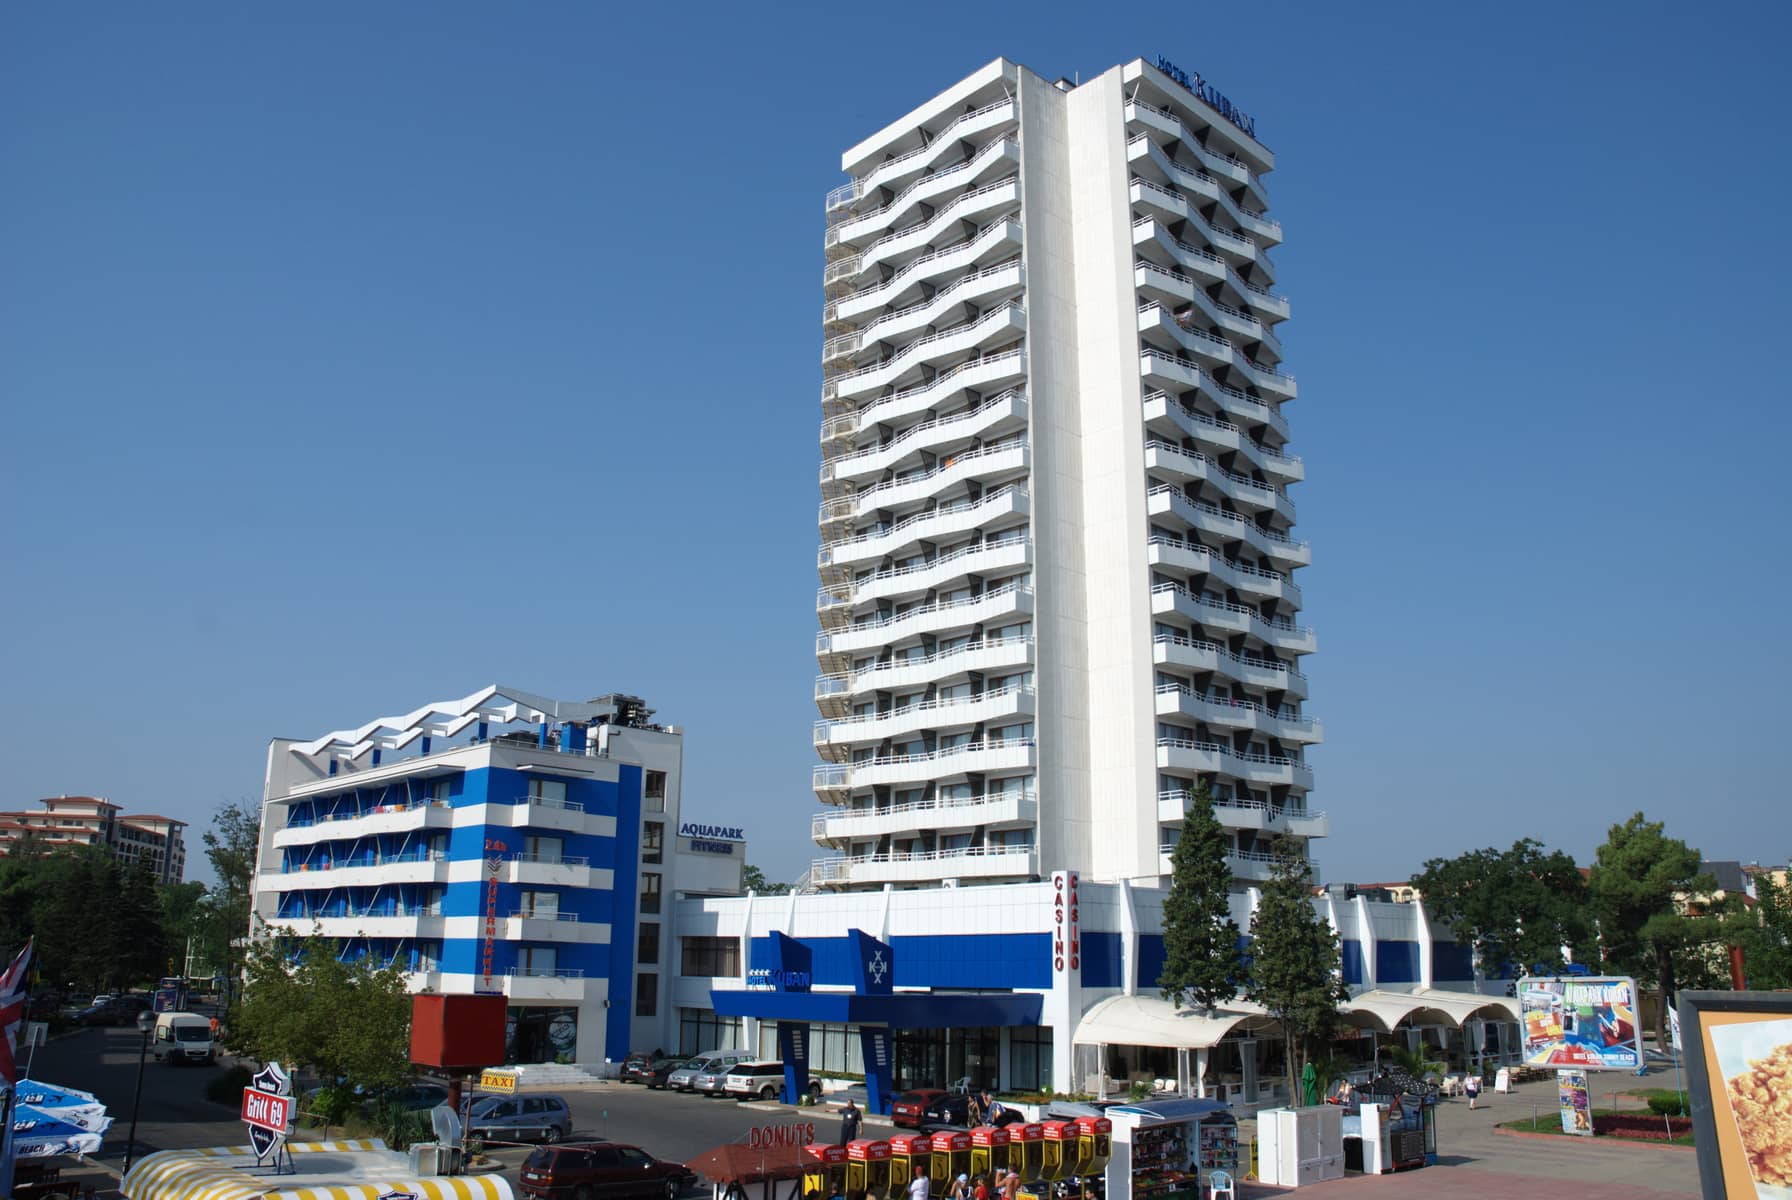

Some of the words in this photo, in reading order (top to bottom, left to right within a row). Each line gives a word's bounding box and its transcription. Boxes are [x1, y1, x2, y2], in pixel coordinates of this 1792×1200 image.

[1156, 54, 1192, 90] HOTEL
[1192, 71, 1256, 138] KUBAN
[681, 823, 744, 839] AQUAPARK
[691, 840, 733, 854] FITNESS
[483, 877, 498, 987] SUPERMARKET
[1054, 875, 1064, 972] CASINO
[1070, 875, 1079, 970] CASINO
[747, 976, 766, 985] HOTEL
[768, 970, 810, 986] KUBAN
[482, 1075, 514, 1088] TAXI
[247, 1094, 268, 1119] Grill
[270, 1100, 283, 1126] 69
[749, 1122, 815, 1148] DONUTS
